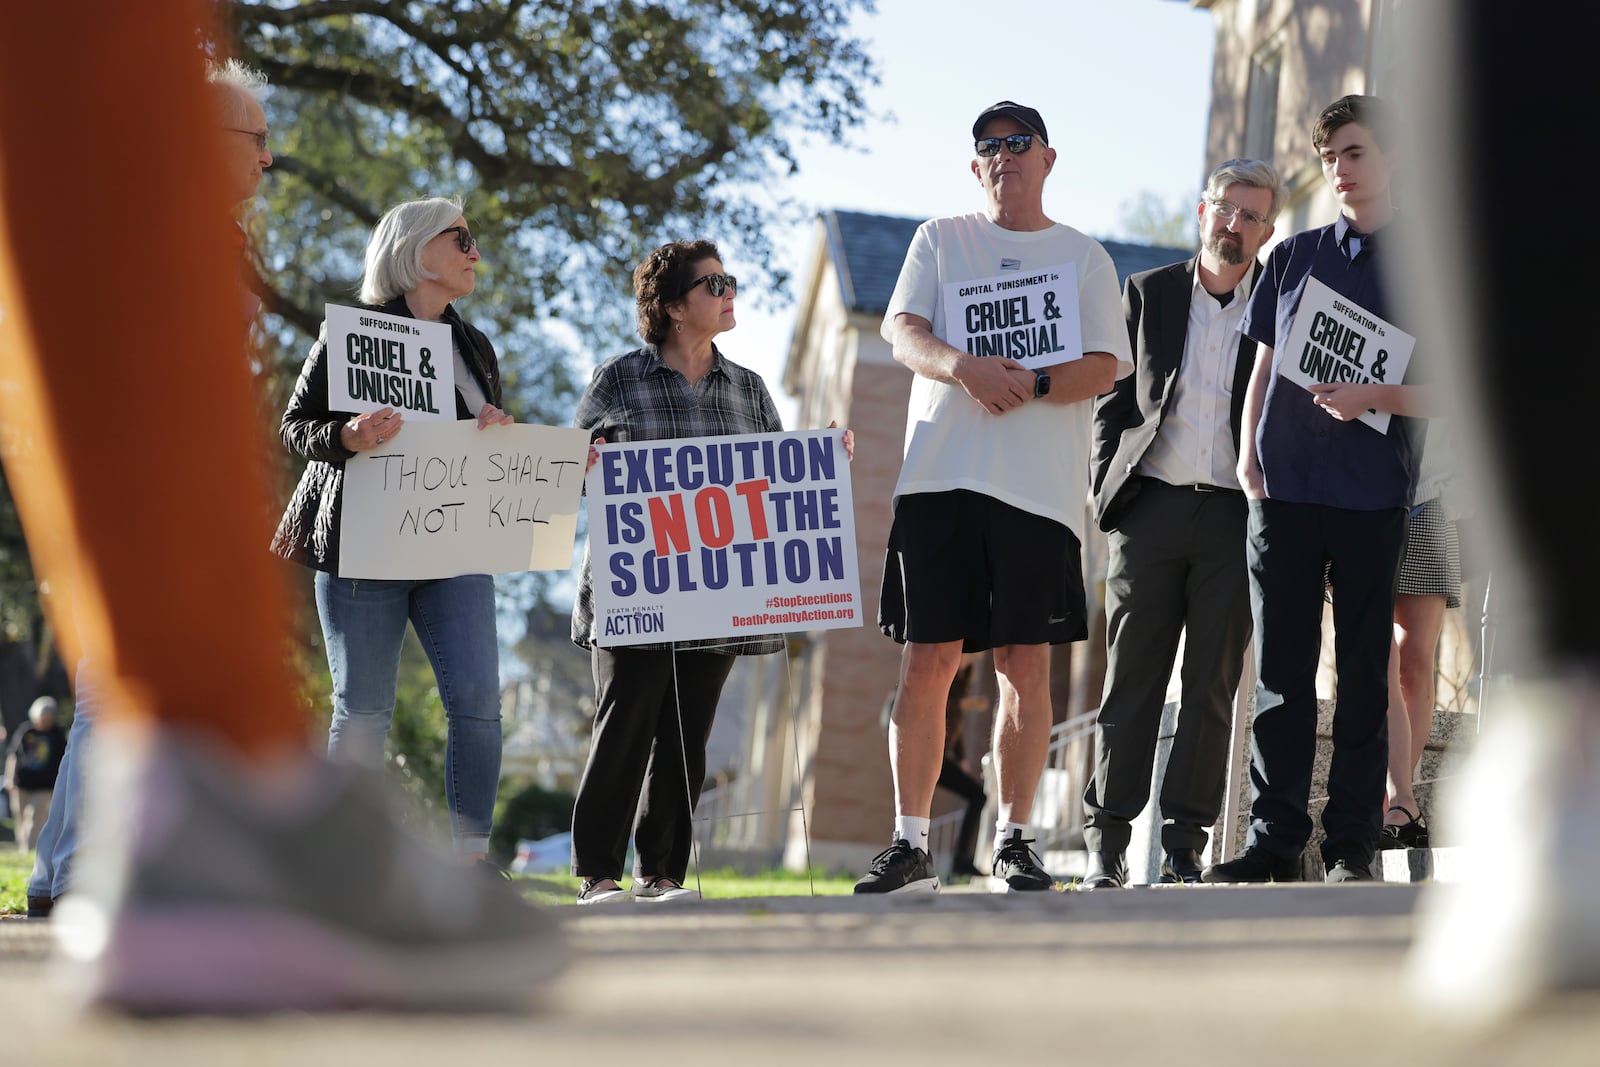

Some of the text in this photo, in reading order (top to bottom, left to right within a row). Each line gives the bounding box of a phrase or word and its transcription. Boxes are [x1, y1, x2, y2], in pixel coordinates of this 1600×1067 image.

[959, 273, 1059, 297] CAPITAL PUNISHMENT is
[359, 316, 420, 336] SUFFOCATION is
[965, 291, 1062, 334] CRUEL &
[1333, 300, 1385, 337] SUFFOCATION is
[346, 333, 437, 380] CRUEL &
[1309, 311, 1388, 383] CRUEL &
[347, 367, 440, 414] UNUSUAL
[369, 453, 579, 491] THOU SHALT
[601, 436, 836, 496] EXECUTION
[399, 494, 550, 535] NOT KILL
[605, 479, 841, 557] IS NOT THE
[609, 536, 845, 597] SOLUTION
[732, 608, 854, 627] DeathPenaltyAction.org
[766, 593, 853, 609] #StopExecutions
[605, 612, 664, 636] ACTION
